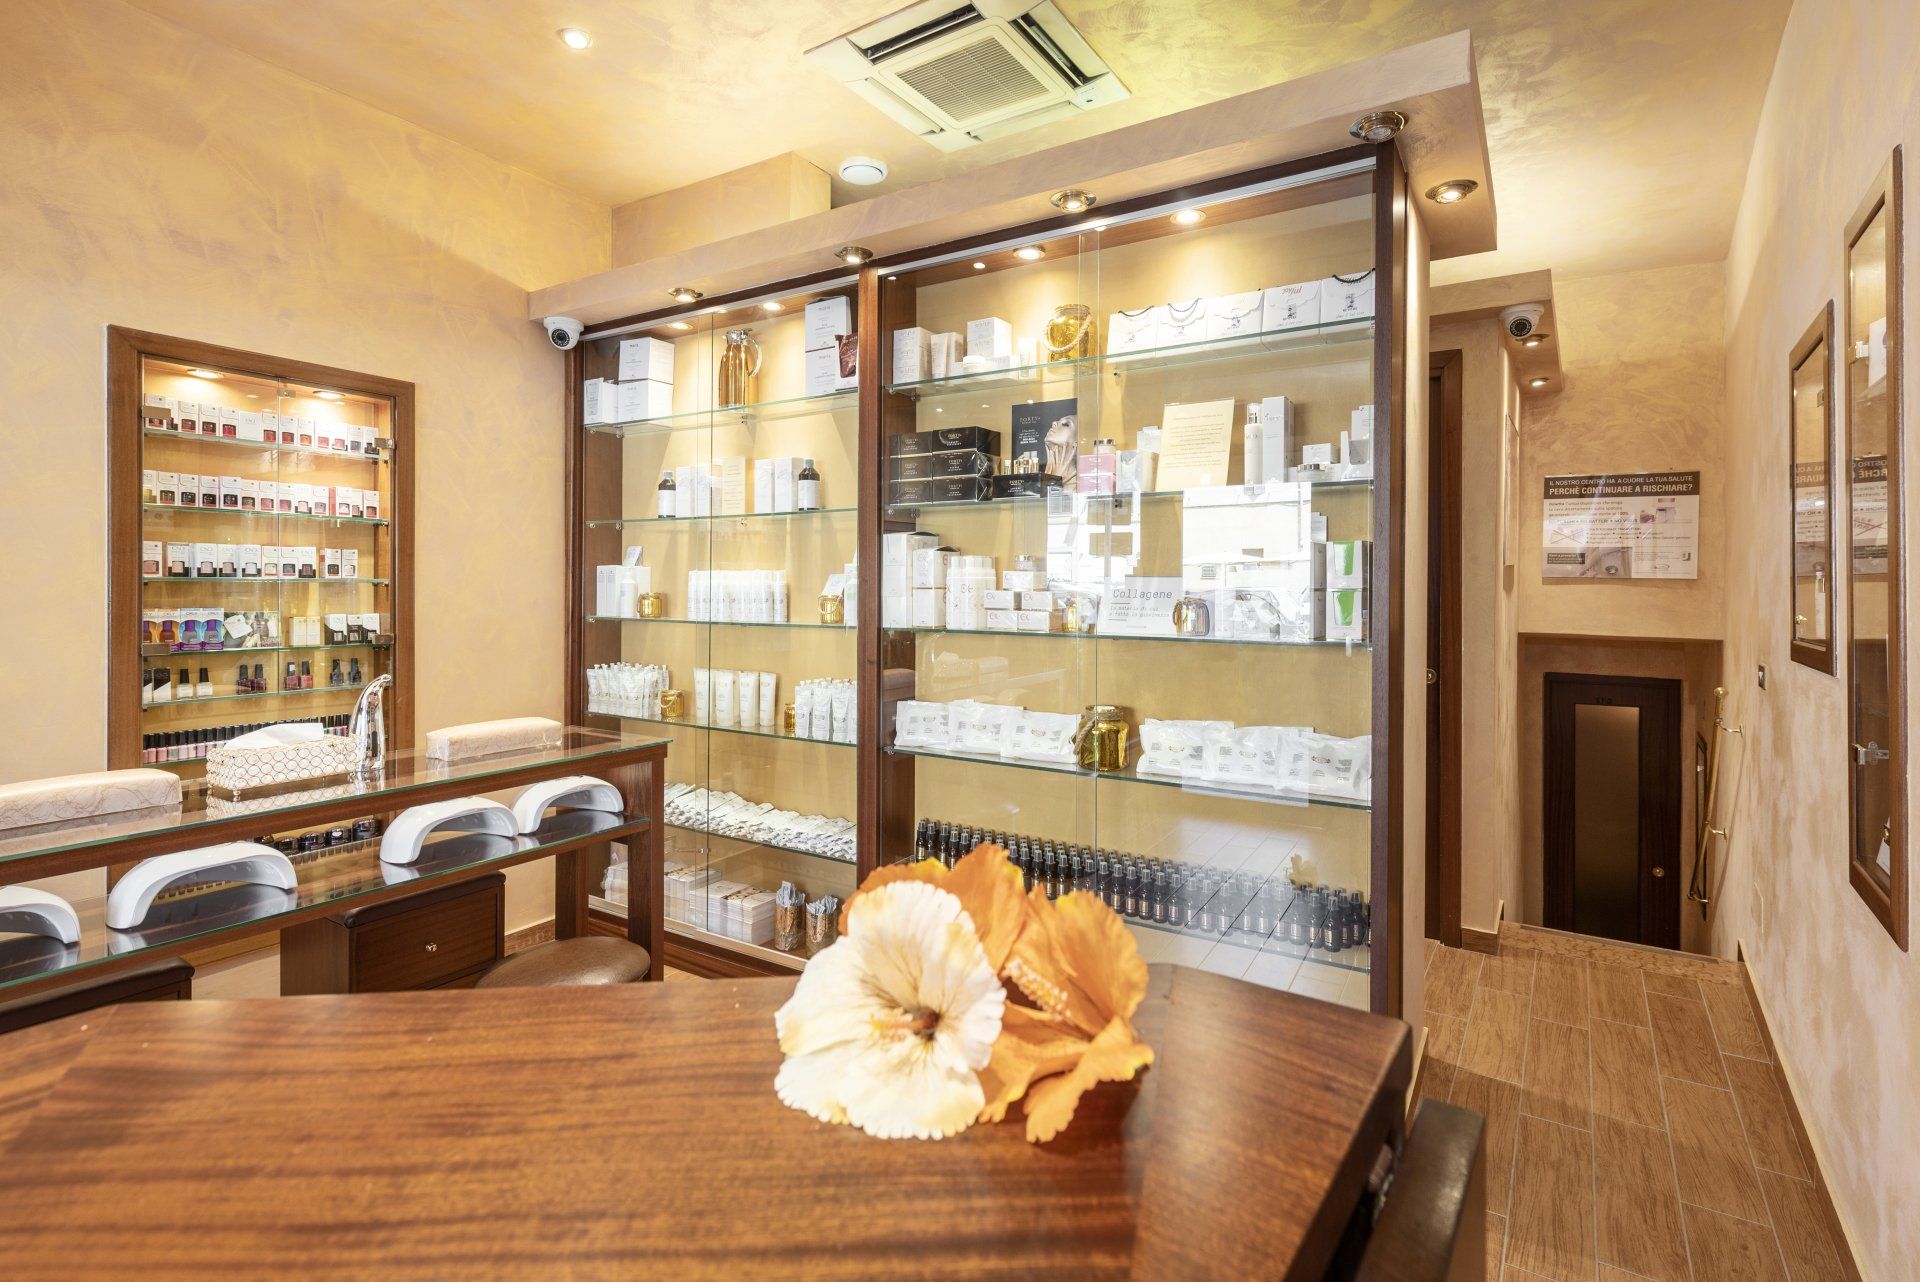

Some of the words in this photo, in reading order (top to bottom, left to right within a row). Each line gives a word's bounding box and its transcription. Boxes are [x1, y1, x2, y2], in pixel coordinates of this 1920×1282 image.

[1581, 485, 1633, 494] CONTINUARE
[1642, 484, 1693, 493] RISCHIARE?
[1113, 588, 1173, 600] Collagene
